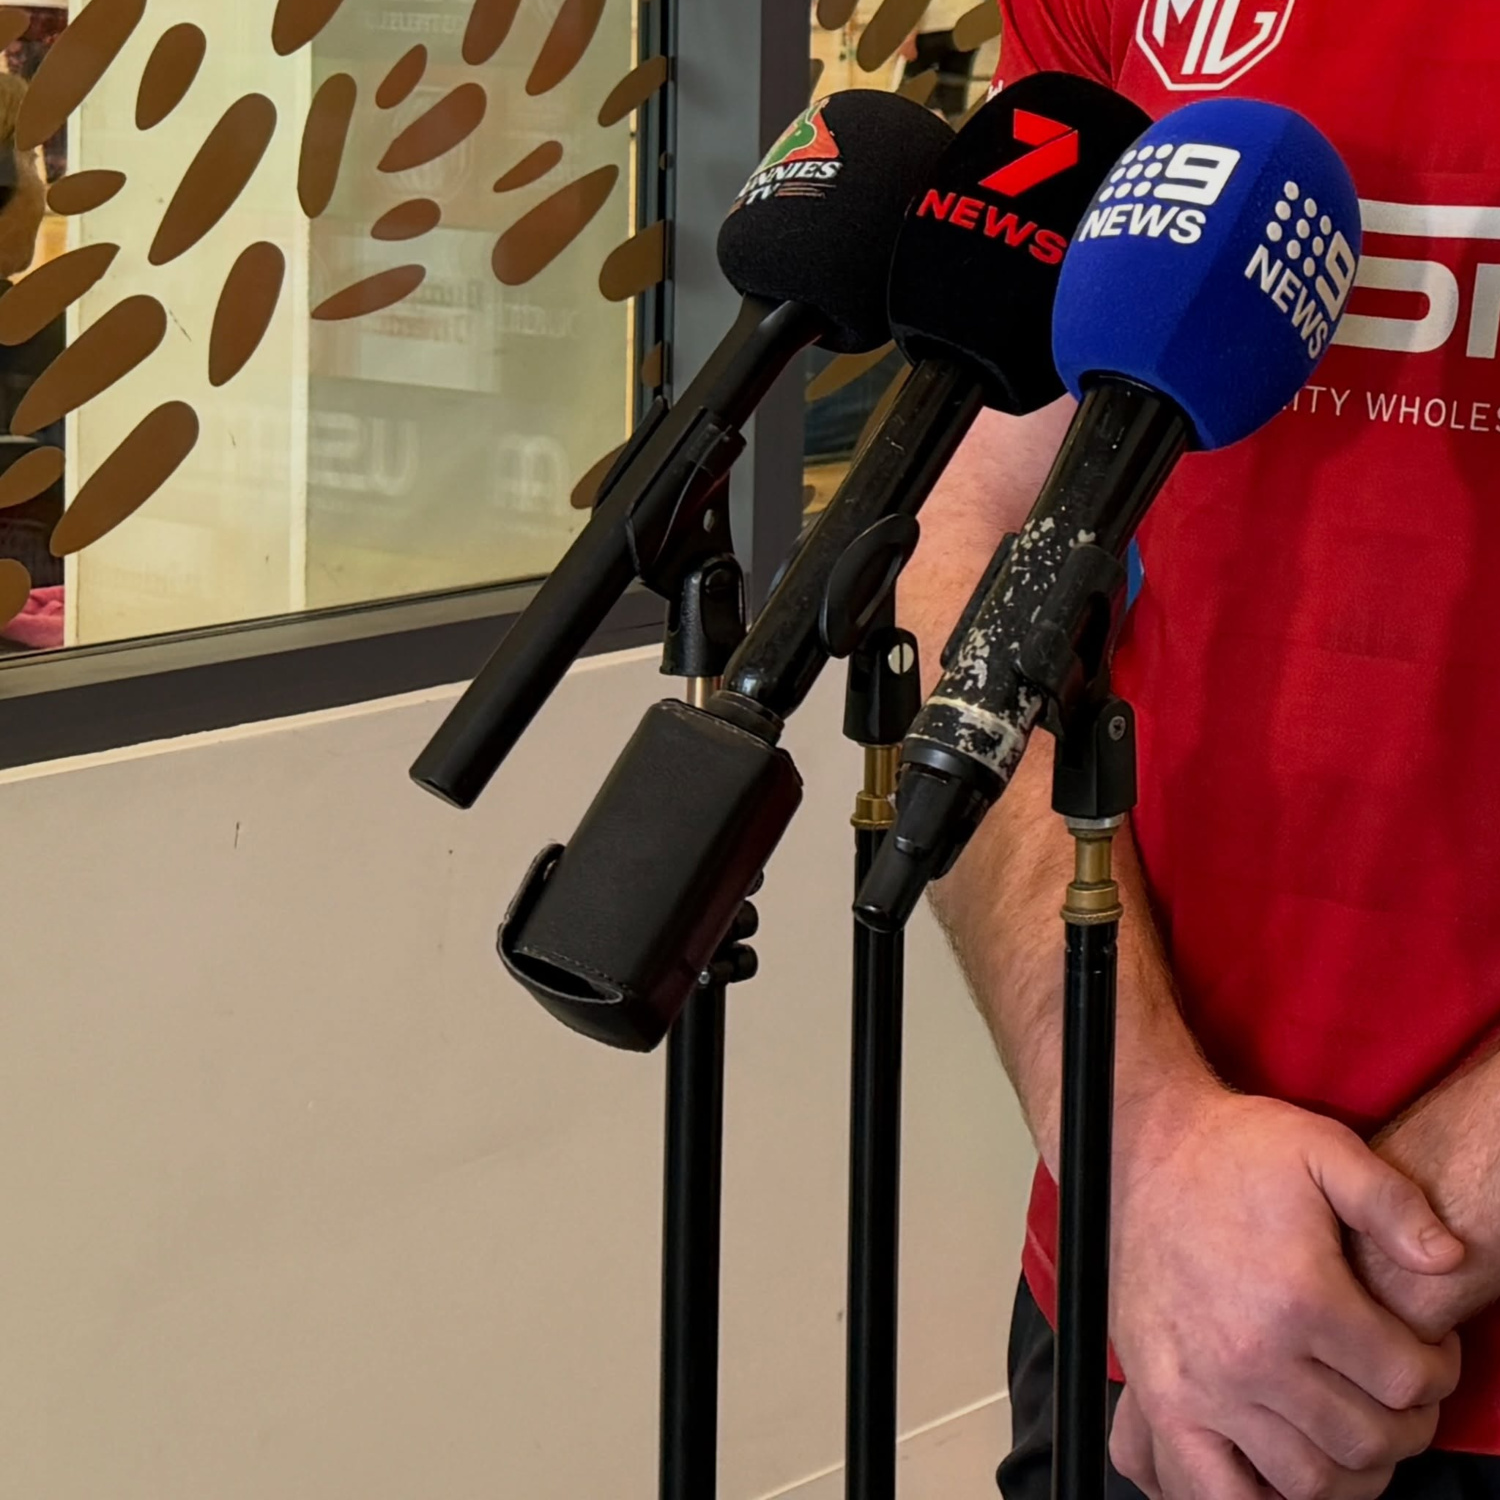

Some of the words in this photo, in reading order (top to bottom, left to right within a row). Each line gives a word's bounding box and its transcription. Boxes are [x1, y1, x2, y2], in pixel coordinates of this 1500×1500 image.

[916, 188, 1068, 266] NEWS
[1077, 202, 1207, 245] NEWS
[1245, 243, 1329, 360] NEWS
